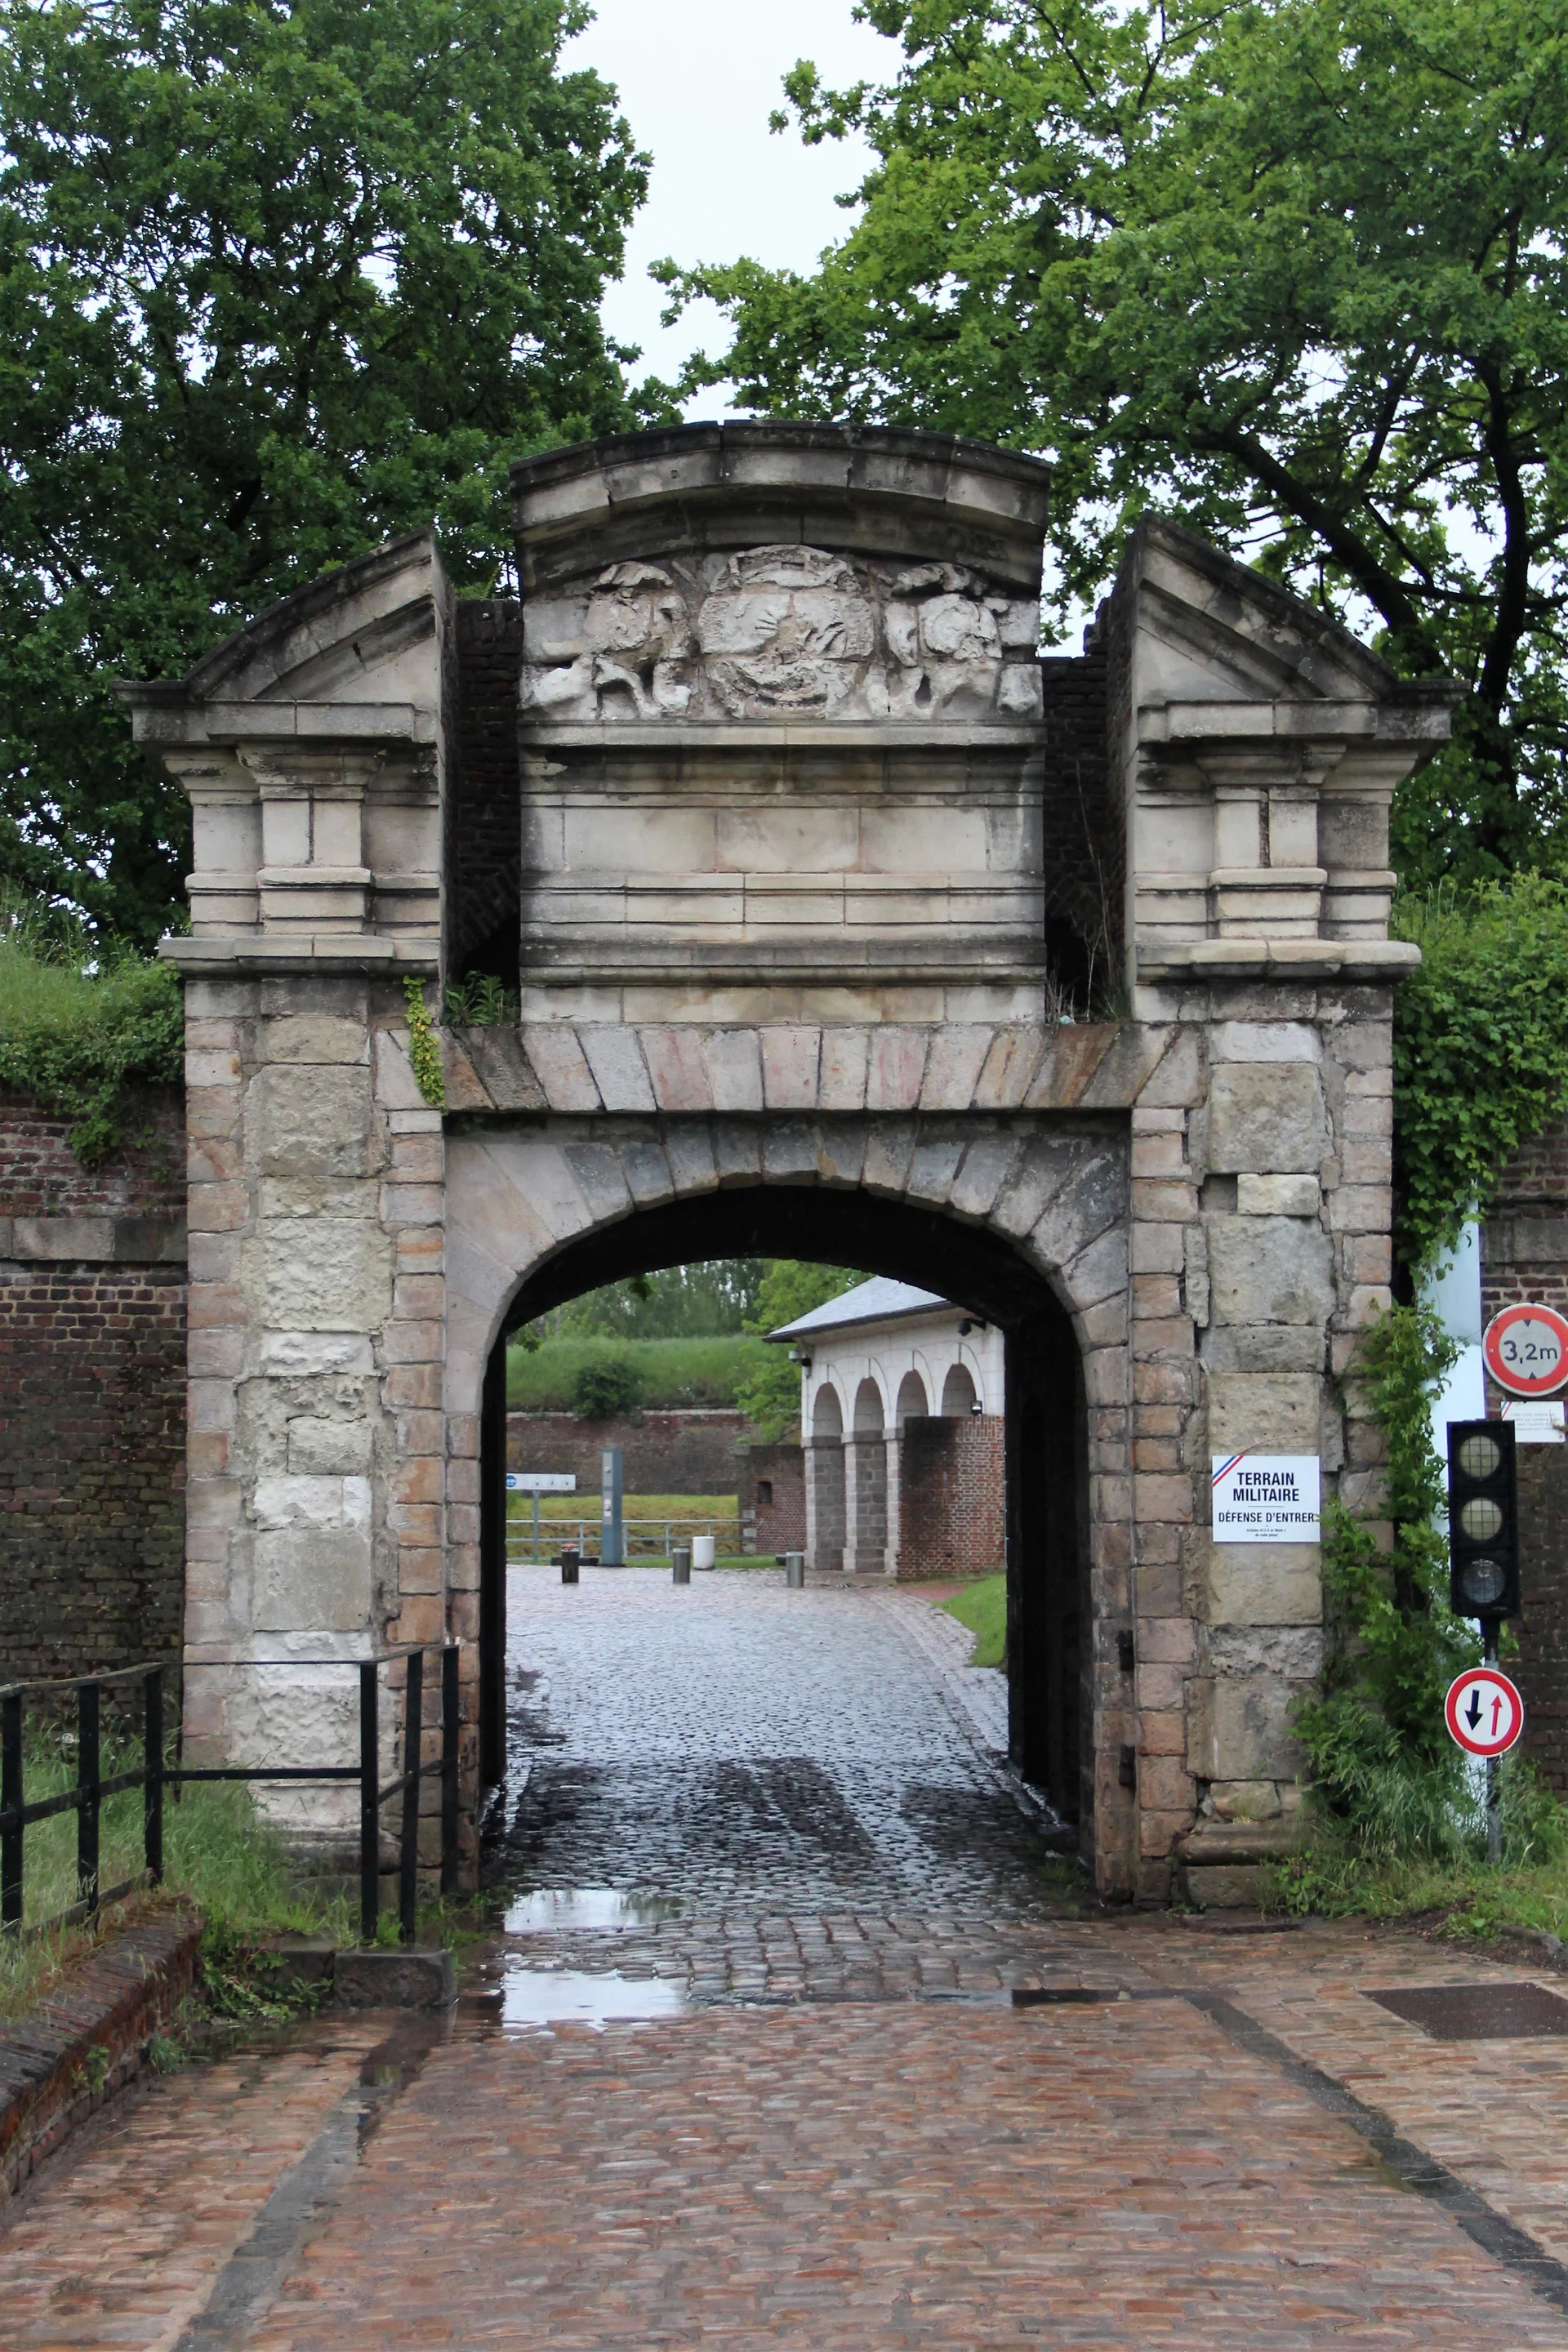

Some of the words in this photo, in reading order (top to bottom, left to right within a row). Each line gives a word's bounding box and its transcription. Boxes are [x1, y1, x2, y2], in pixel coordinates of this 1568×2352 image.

[1237, 1472, 1294, 1486] TERRAIN
[1233, 1488, 1299, 1502] MILITAIRE
[1218, 1510, 1263, 1522] DÉFENSE
[1266, 1512, 1314, 1522] D'ENTRER
